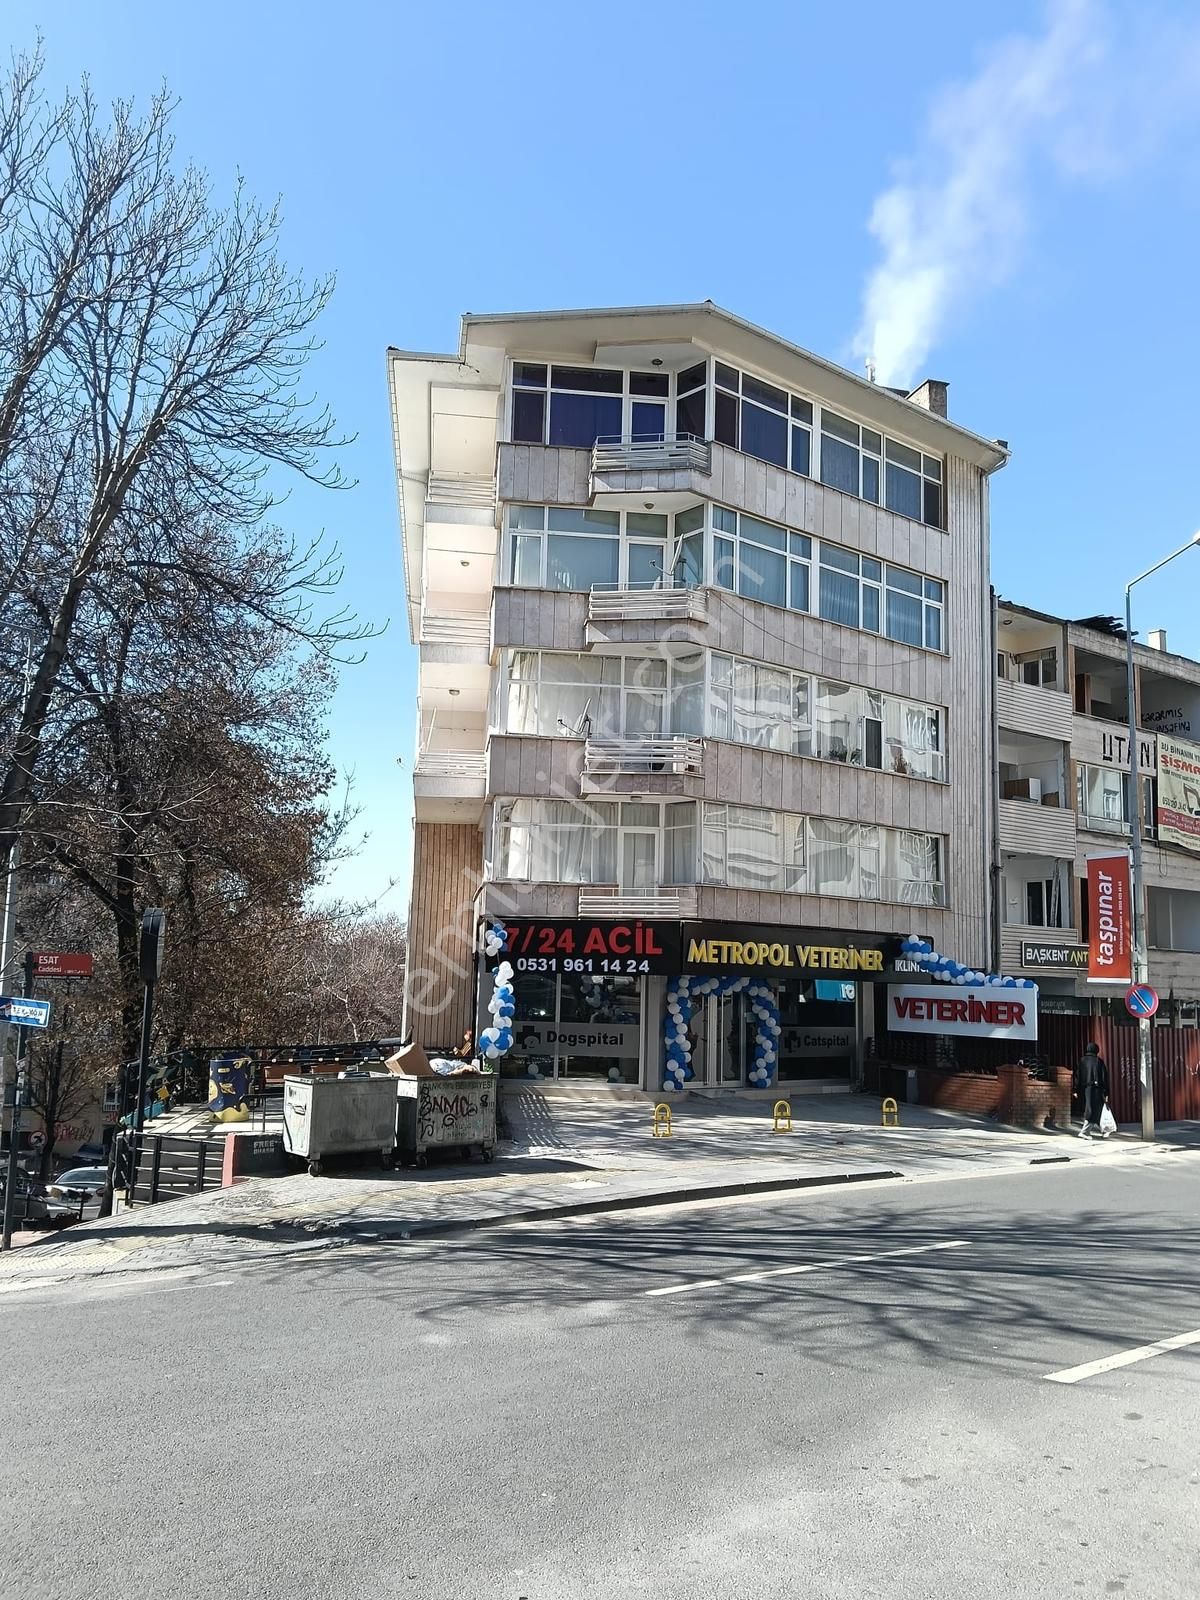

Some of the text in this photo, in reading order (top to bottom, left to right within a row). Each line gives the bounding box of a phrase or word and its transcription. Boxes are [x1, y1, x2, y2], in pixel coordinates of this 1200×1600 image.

[1096, 870, 1118, 966] taşpınar
[583, 921, 663, 955] ACİL
[38, 955, 60, 965] ESAT
[687, 938, 885, 972] METROPOL VETERİNER
[1026, 947, 1069, 964] BAŞKENT
[516, 957, 651, 973] 0531 961 14 24
[893, 994, 1026, 1026] VETERİNER
[546, 1030, 624, 1046] Dogspital
[803, 1035, 849, 1049] Catspital
